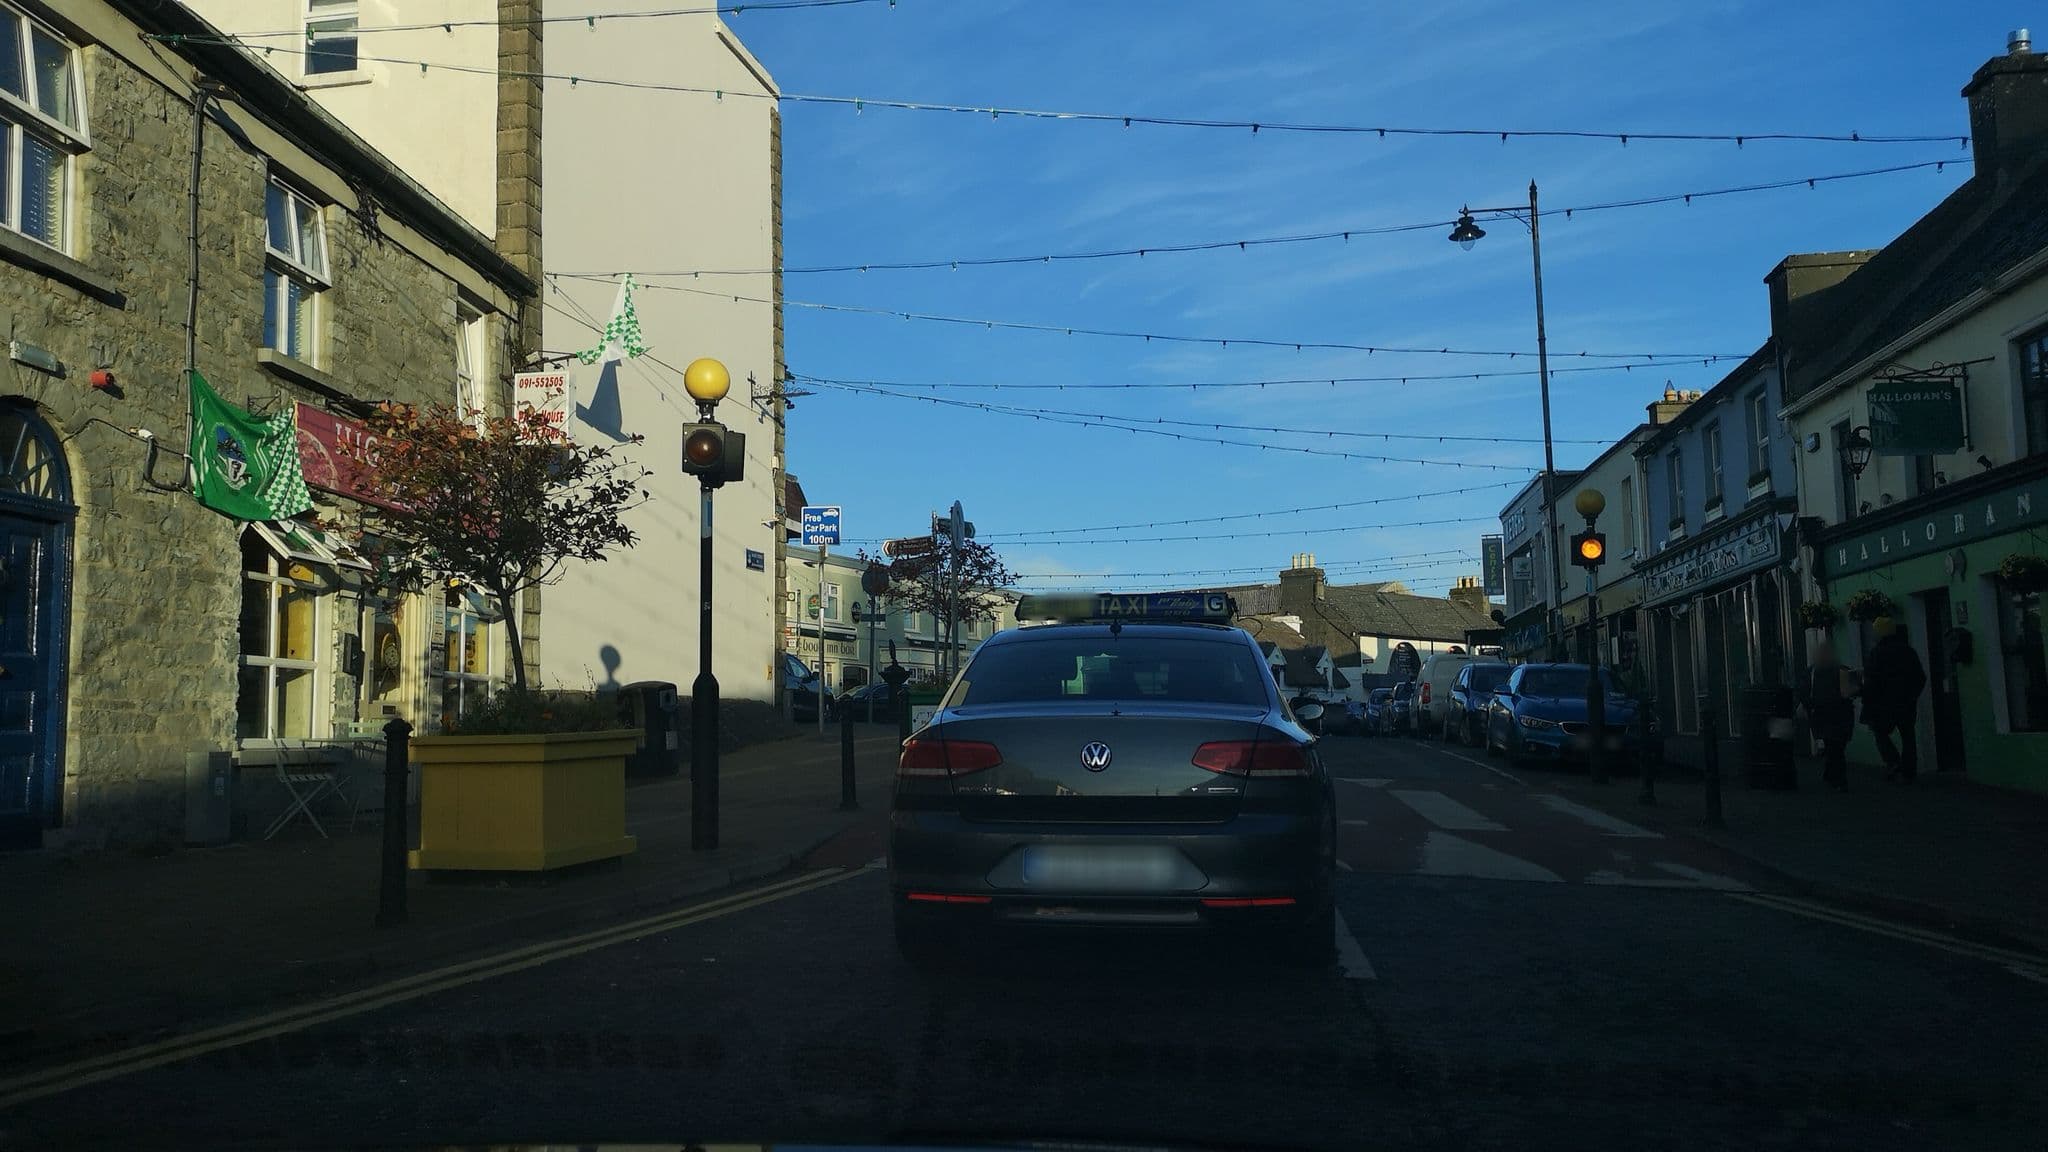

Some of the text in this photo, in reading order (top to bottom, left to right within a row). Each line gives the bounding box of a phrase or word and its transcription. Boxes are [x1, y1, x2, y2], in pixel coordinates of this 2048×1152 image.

[519, 377, 564, 389] 091-552505
[1868, 390, 1953, 403] HALLORAN'S
[541, 410, 565, 423] HOUSE
[804, 513, 822, 522] Free
[805, 524, 837, 532] Car Park
[1838, 492, 2032, 567] HALLORAN
[808, 535, 834, 544] 100m
[1098, 595, 1149, 616] TAXI
